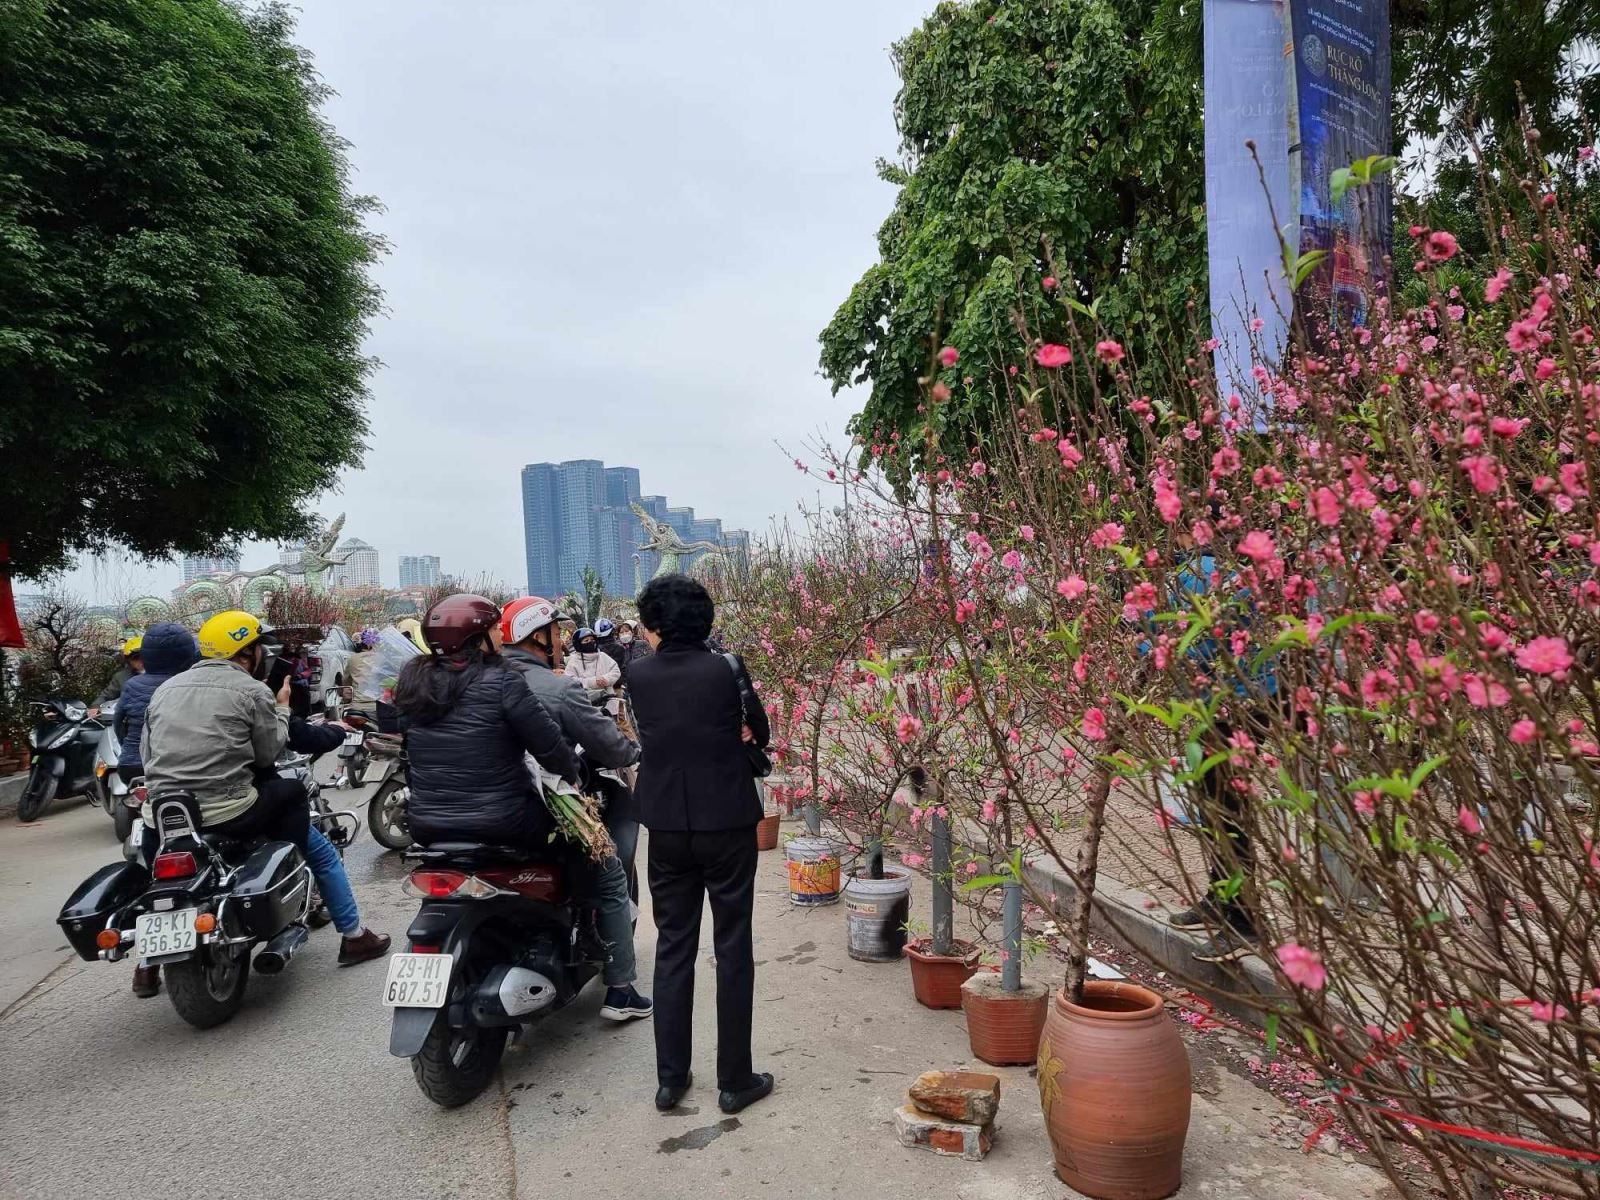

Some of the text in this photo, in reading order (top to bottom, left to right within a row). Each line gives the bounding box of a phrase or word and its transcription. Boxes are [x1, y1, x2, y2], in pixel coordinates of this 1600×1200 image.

[228, 626, 250, 642] be
[145, 912, 188, 935] 29-K1
[140, 930, 192, 955] 356.52
[397, 957, 442, 978] 29-H1
[388, 981, 442, 1004] 687.51
